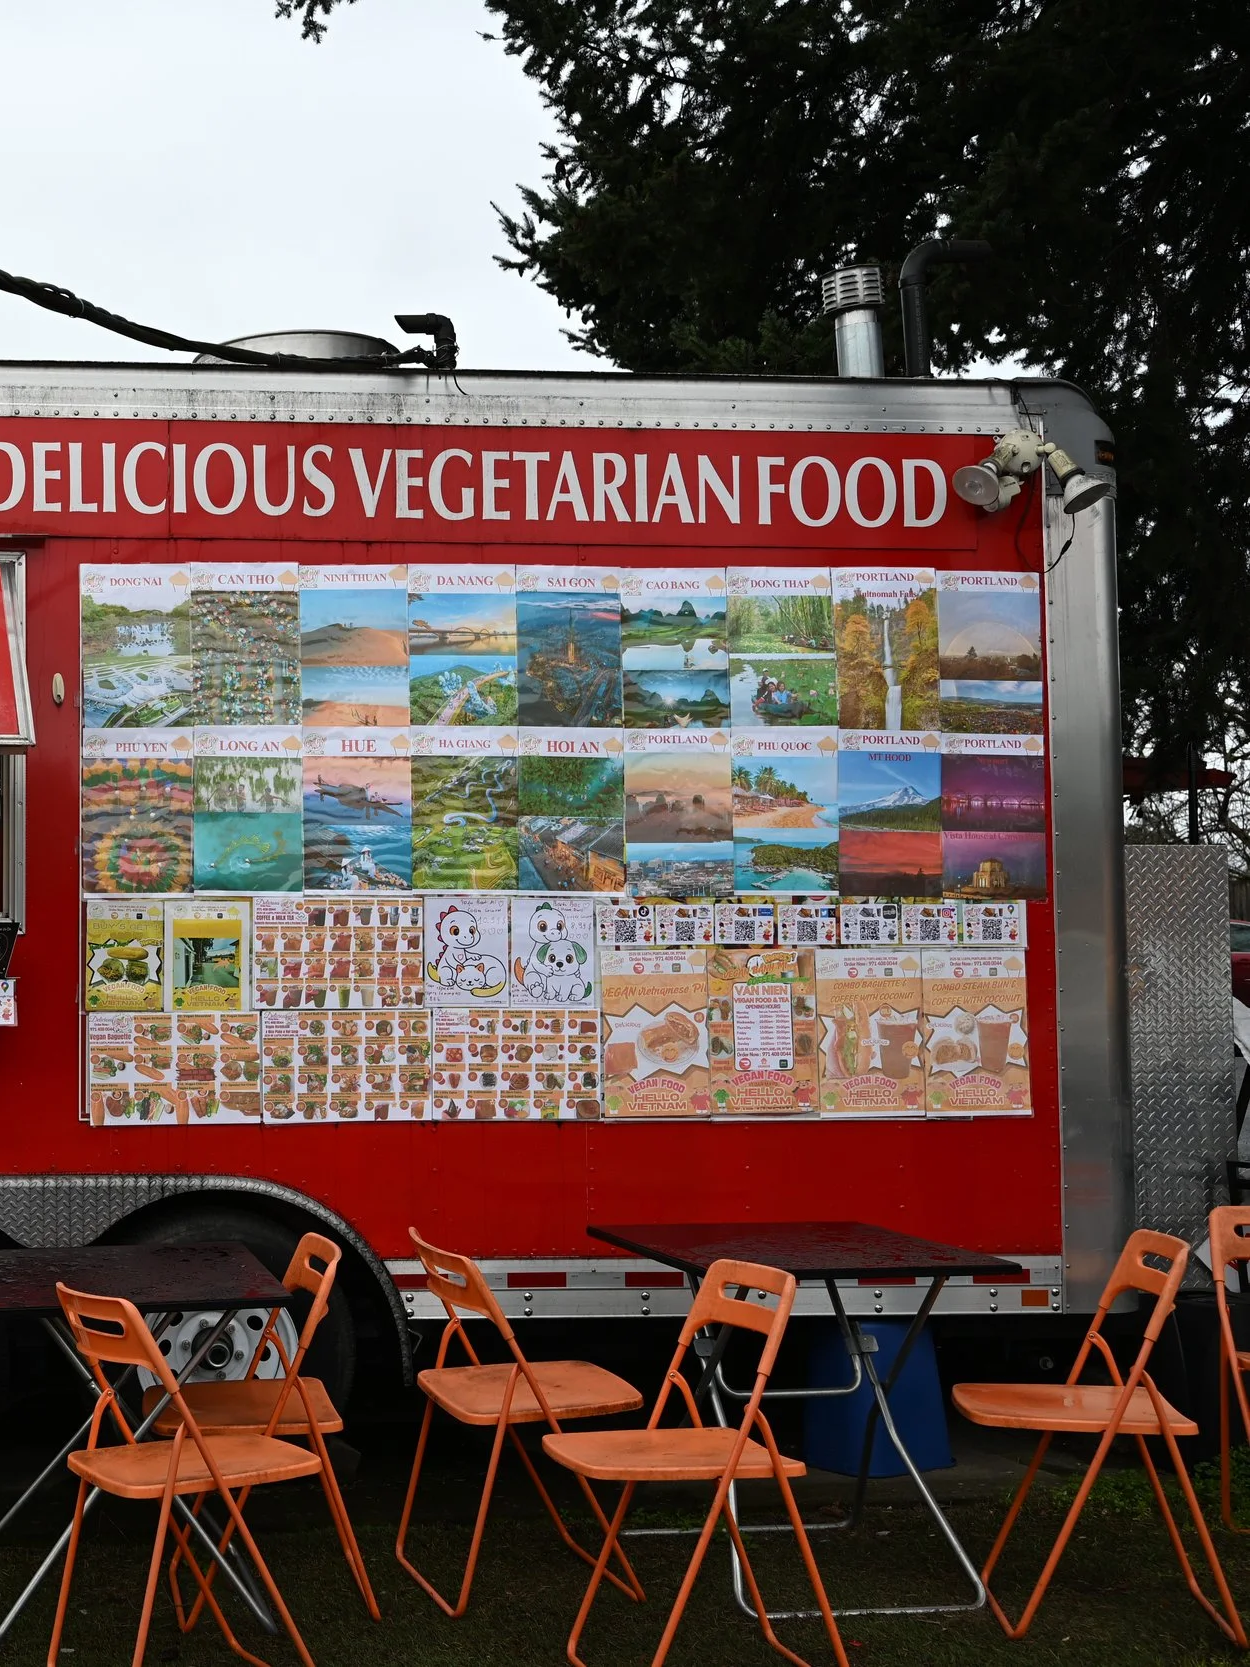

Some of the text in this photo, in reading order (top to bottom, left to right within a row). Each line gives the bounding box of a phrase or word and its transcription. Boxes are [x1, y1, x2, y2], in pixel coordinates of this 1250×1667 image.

[348, 448, 740, 525] VEGETARIAN
[757, 457, 947, 528] FOOD
[110, 577, 162, 587] DONG NAI
[217, 574, 275, 585] CAN THO
[323, 573, 387, 583] NINH THUAN
[436, 575, 493, 586] DA NANG
[856, 572, 914, 582] PORTLAND
[960, 576, 1018, 586] PORTLAND
[547, 578, 596, 588] SAI GON
[646, 581, 700, 590] CAO BANG
[751, 579, 810, 589] DONG THAP
[439, 739, 491, 749] HA GIANG
[648, 734, 708, 745] PORTLAND
[862, 735, 920, 746] PORTLAND
[964, 739, 1022, 749] PORTLAND
[115, 742, 168, 752] PHU YEN
[219, 740, 280, 751] LONG AN
[341, 739, 376, 753] HUE
[547, 741, 600, 754] HOI AN
[757, 741, 812, 751] PHU QUOC
[868, 753, 912, 762] MT HOOD
[103, 983, 145, 994] VEGAN FOOD
[187, 985, 226, 994] VEGAN FOOD
[833, 980, 899, 990] COMBO BAGUETTE
[931, 980, 1009, 992] COMBO STEAM BUN
[734, 985, 788, 996] VAN NIEN
[830, 995, 859, 1003] COFFEE
[879, 992, 915, 1001] COCONUT
[931, 994, 1022, 1006] COFFEE WITH COCONUT
[90, 1033, 132, 1041] Vegan Baguette
[731, 1070, 793, 1086] VEGAN FOOD
[949, 1075, 1002, 1090] VEGAN FOOD
[627, 1079, 686, 1094] VEGAN FOOD
[843, 1077, 897, 1090] VEGAN FOOD
[737, 1088, 785, 1097] HELLO
[849, 1089, 892, 1098] HELLO
[955, 1088, 997, 1097] HELLO
[634, 1093, 680, 1103] HELLO
[731, 1097, 792, 1105] VIETNAM
[843, 1097, 898, 1106] VIETNAM
[950, 1096, 1004, 1106] VIETNAM
[628, 1102, 687, 1111] VIETNAM
